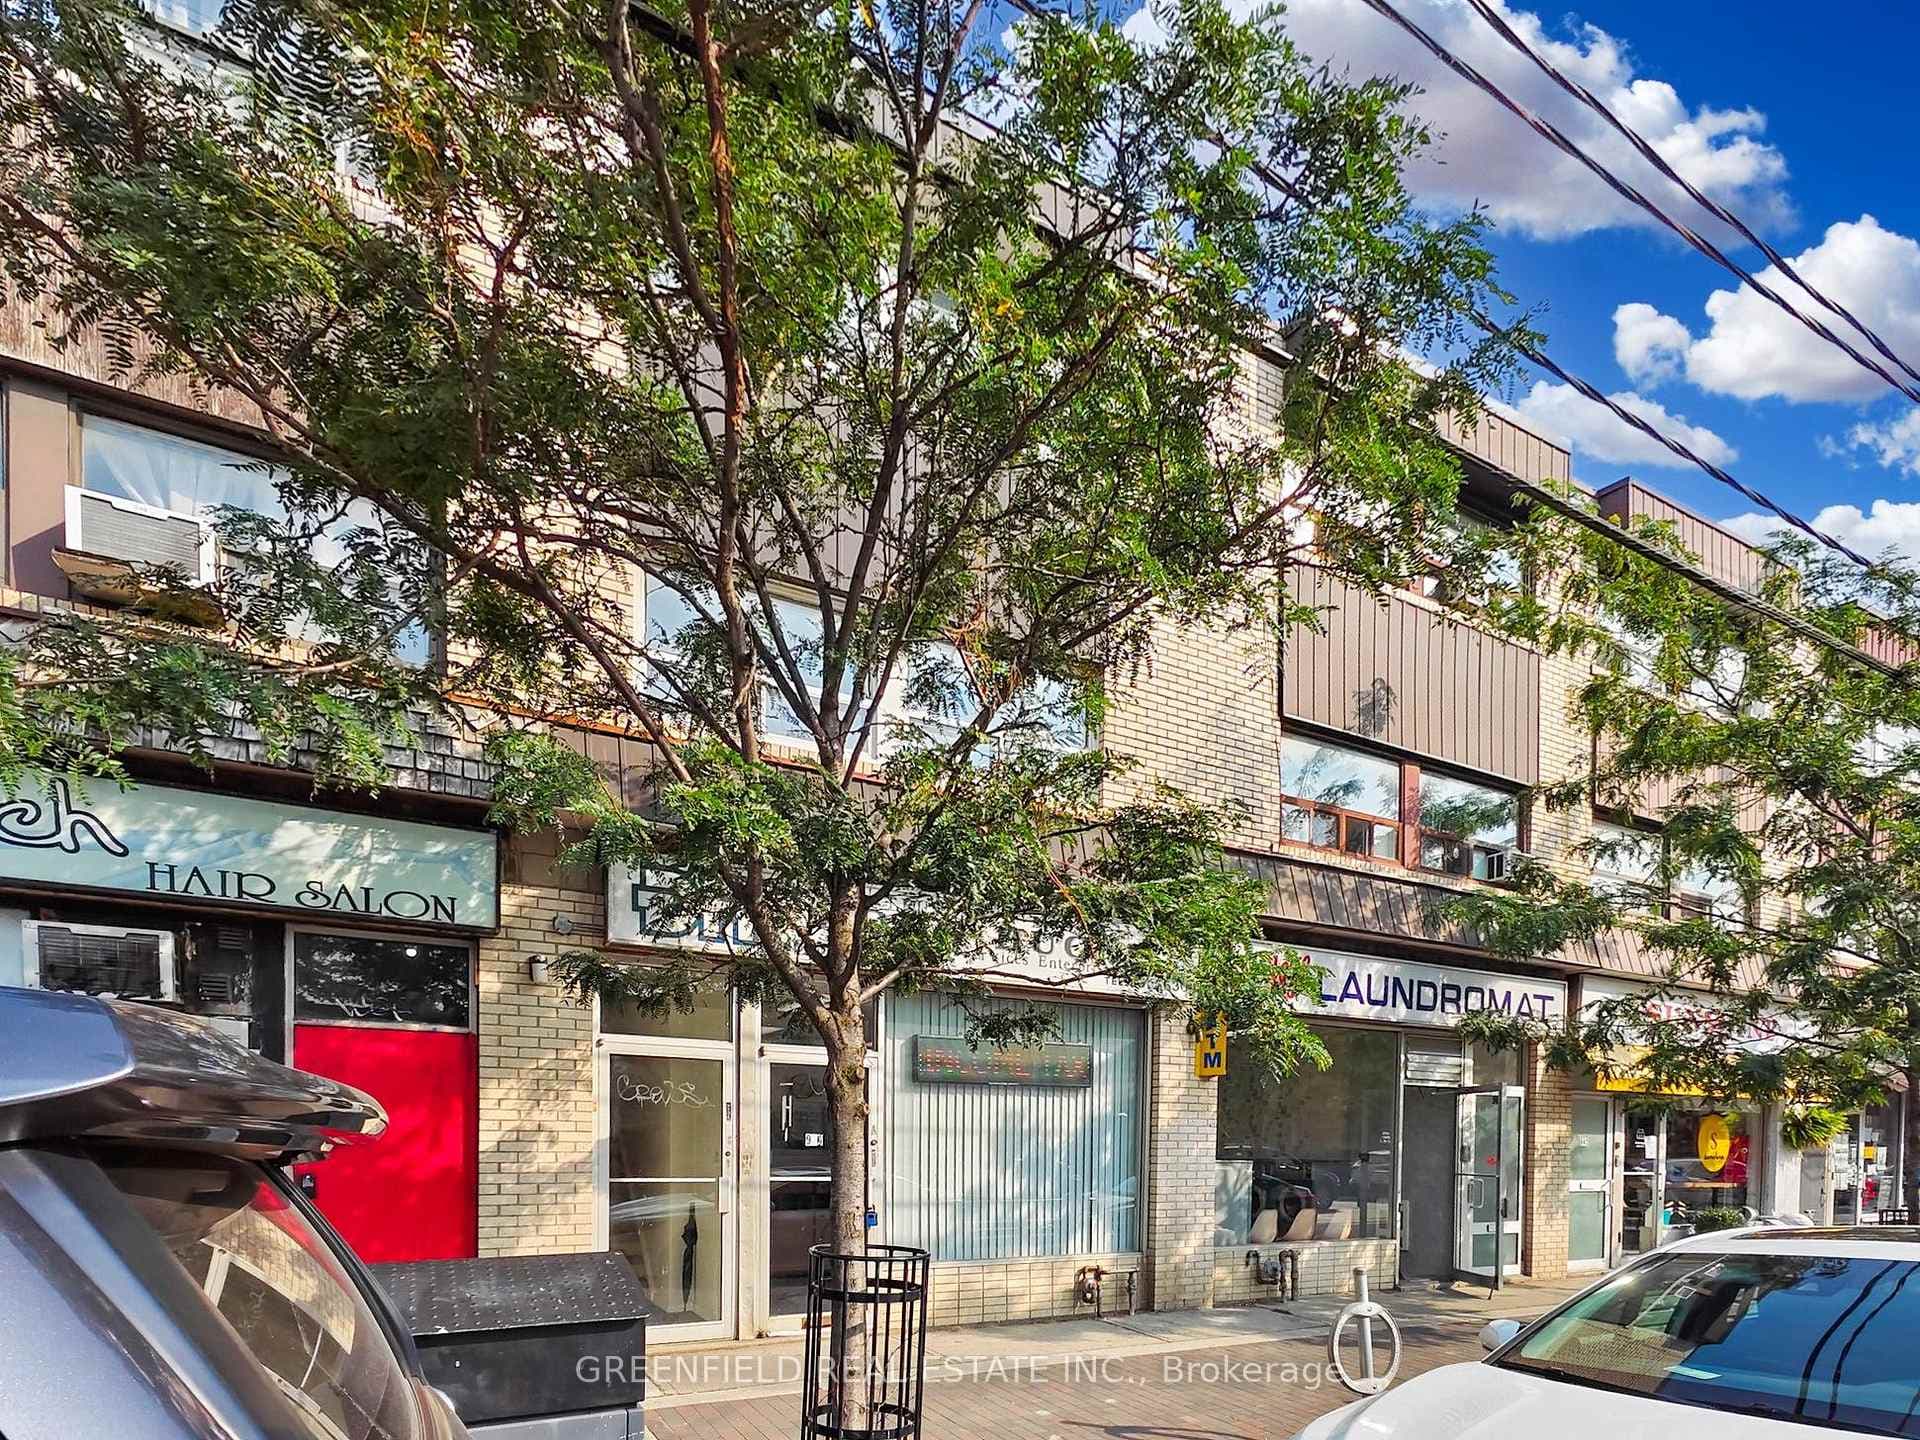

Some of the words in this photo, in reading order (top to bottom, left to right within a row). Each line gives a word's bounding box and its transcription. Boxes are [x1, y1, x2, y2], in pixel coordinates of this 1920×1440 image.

[146, 861, 277, 903] HAIR
[295, 880, 456, 922] SALON
[1317, 970, 1554, 1020] LAUNDROMAT
